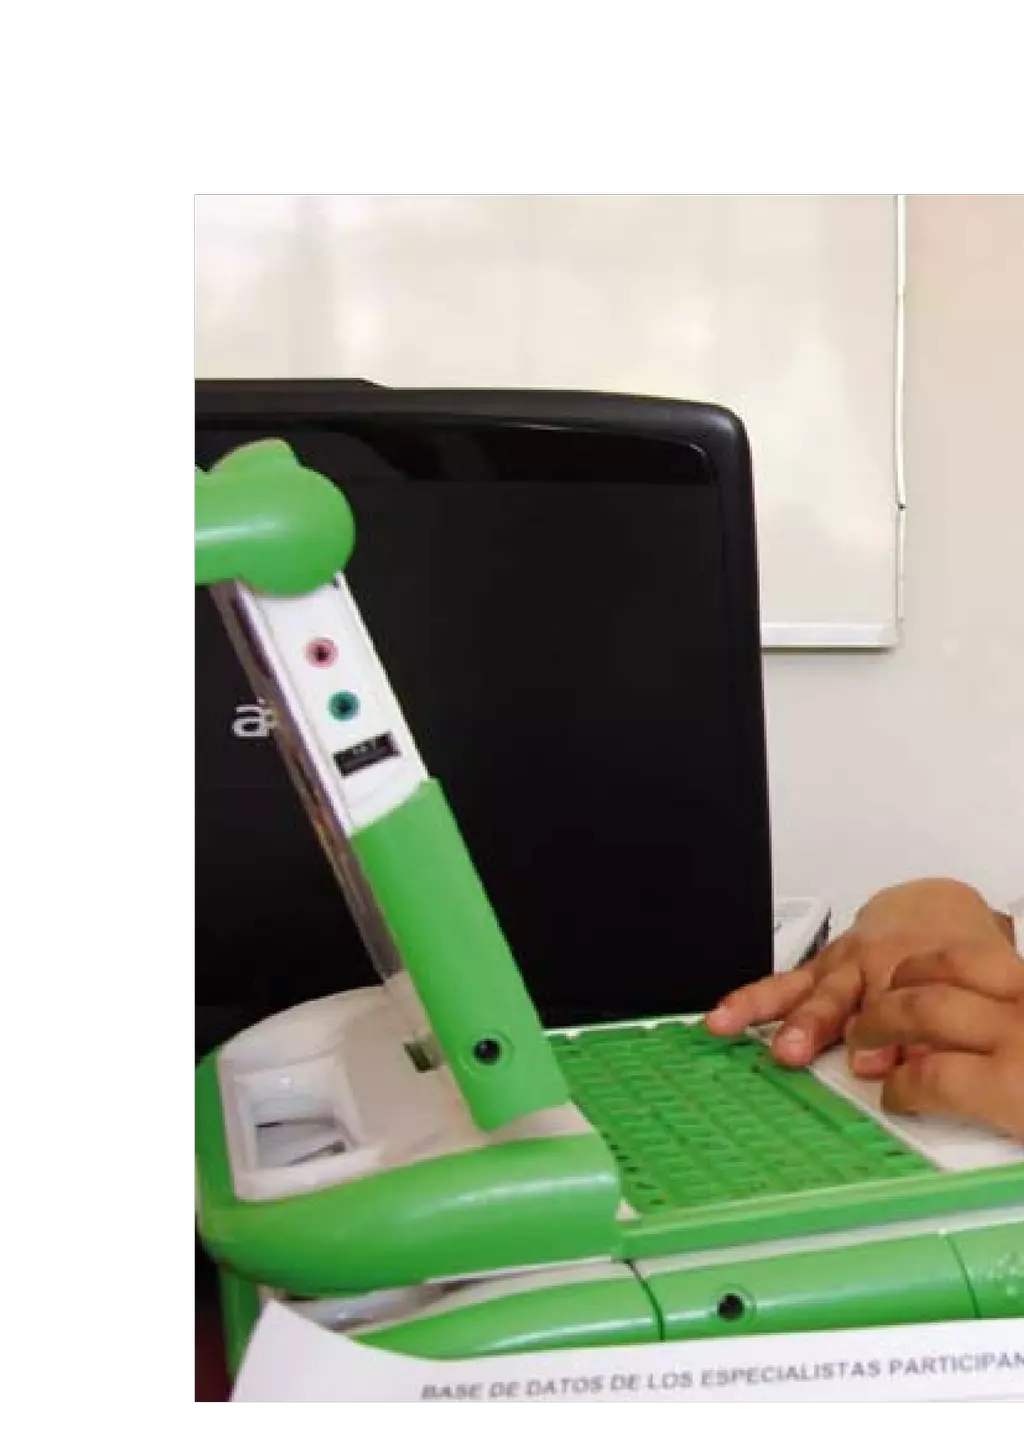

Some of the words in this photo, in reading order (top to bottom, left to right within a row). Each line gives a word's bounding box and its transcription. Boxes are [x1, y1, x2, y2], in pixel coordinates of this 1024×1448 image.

[420, 1381, 483, 1400] BASE
[488, 1380, 520, 1398] DE
[525, 1374, 603, 1397] DATOS
[609, 1373, 640, 1392] DE
[647, 1370, 694, 1391] LOS
[700, 1358, 882, 1388] ESPECIALISTAS
